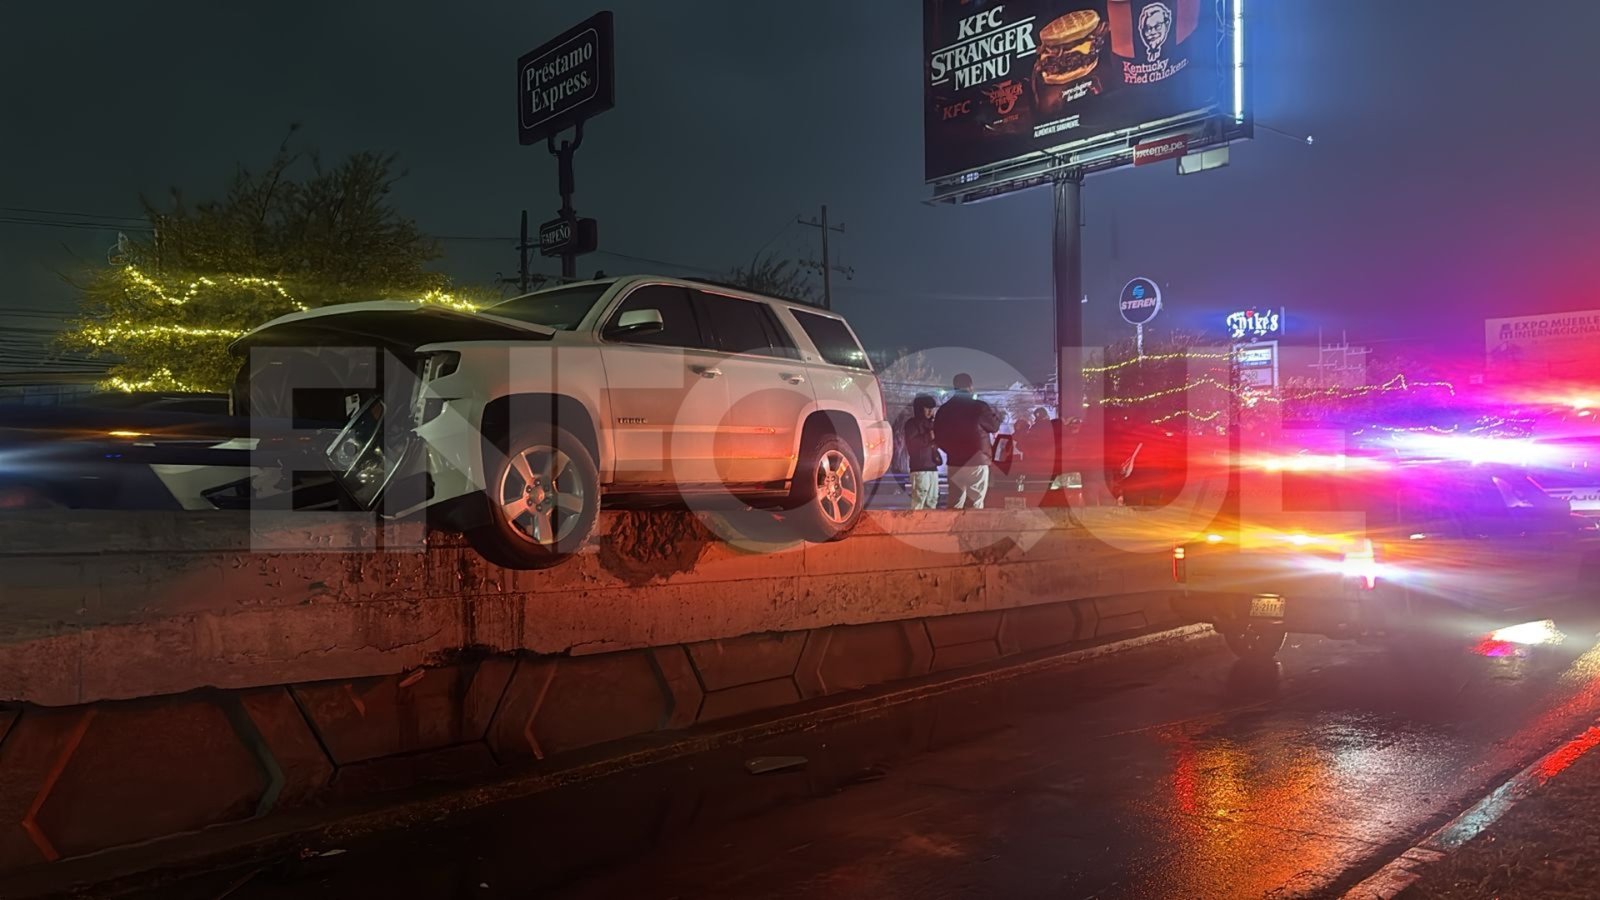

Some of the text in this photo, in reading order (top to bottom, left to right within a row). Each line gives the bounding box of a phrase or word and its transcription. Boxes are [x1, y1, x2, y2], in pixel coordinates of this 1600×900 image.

[957, 5, 1003, 41] KFC
[931, 22, 1037, 81] STRANGER
[526, 41, 593, 91] Préstamo
[954, 54, 1011, 91] MENU
[1122, 58, 1169, 76] Kentucky
[1124, 58, 1187, 84] Fried Chicken
[531, 69, 589, 114] Express
[942, 99, 971, 121] KFC
[1121, 297, 1156, 310] STEREN
[1514, 320, 1549, 331] EXPO
[1514, 325, 1600, 339] INTERNACIONAL
